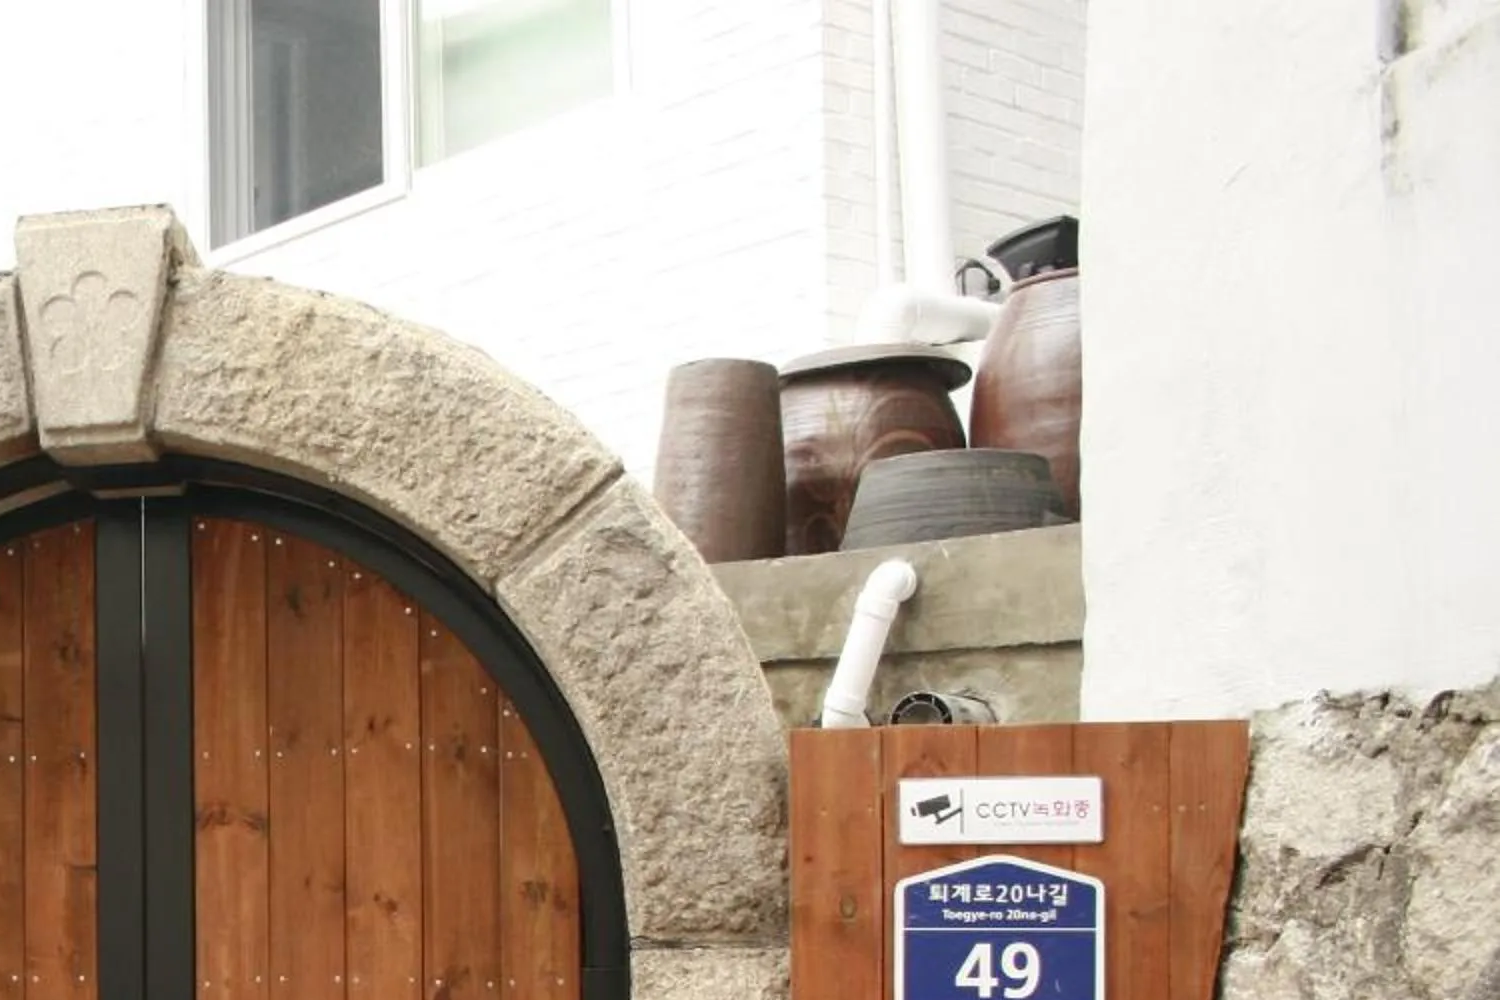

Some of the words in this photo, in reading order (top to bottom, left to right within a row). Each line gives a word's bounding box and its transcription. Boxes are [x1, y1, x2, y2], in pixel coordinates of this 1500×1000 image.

[928, 883, 1068, 907] 퇴계로20나길
[941, 909, 1003, 923] Toegye-ro
[1006, 909, 1057, 922] 20na-gil
[954, 942, 1041, 999] 49
